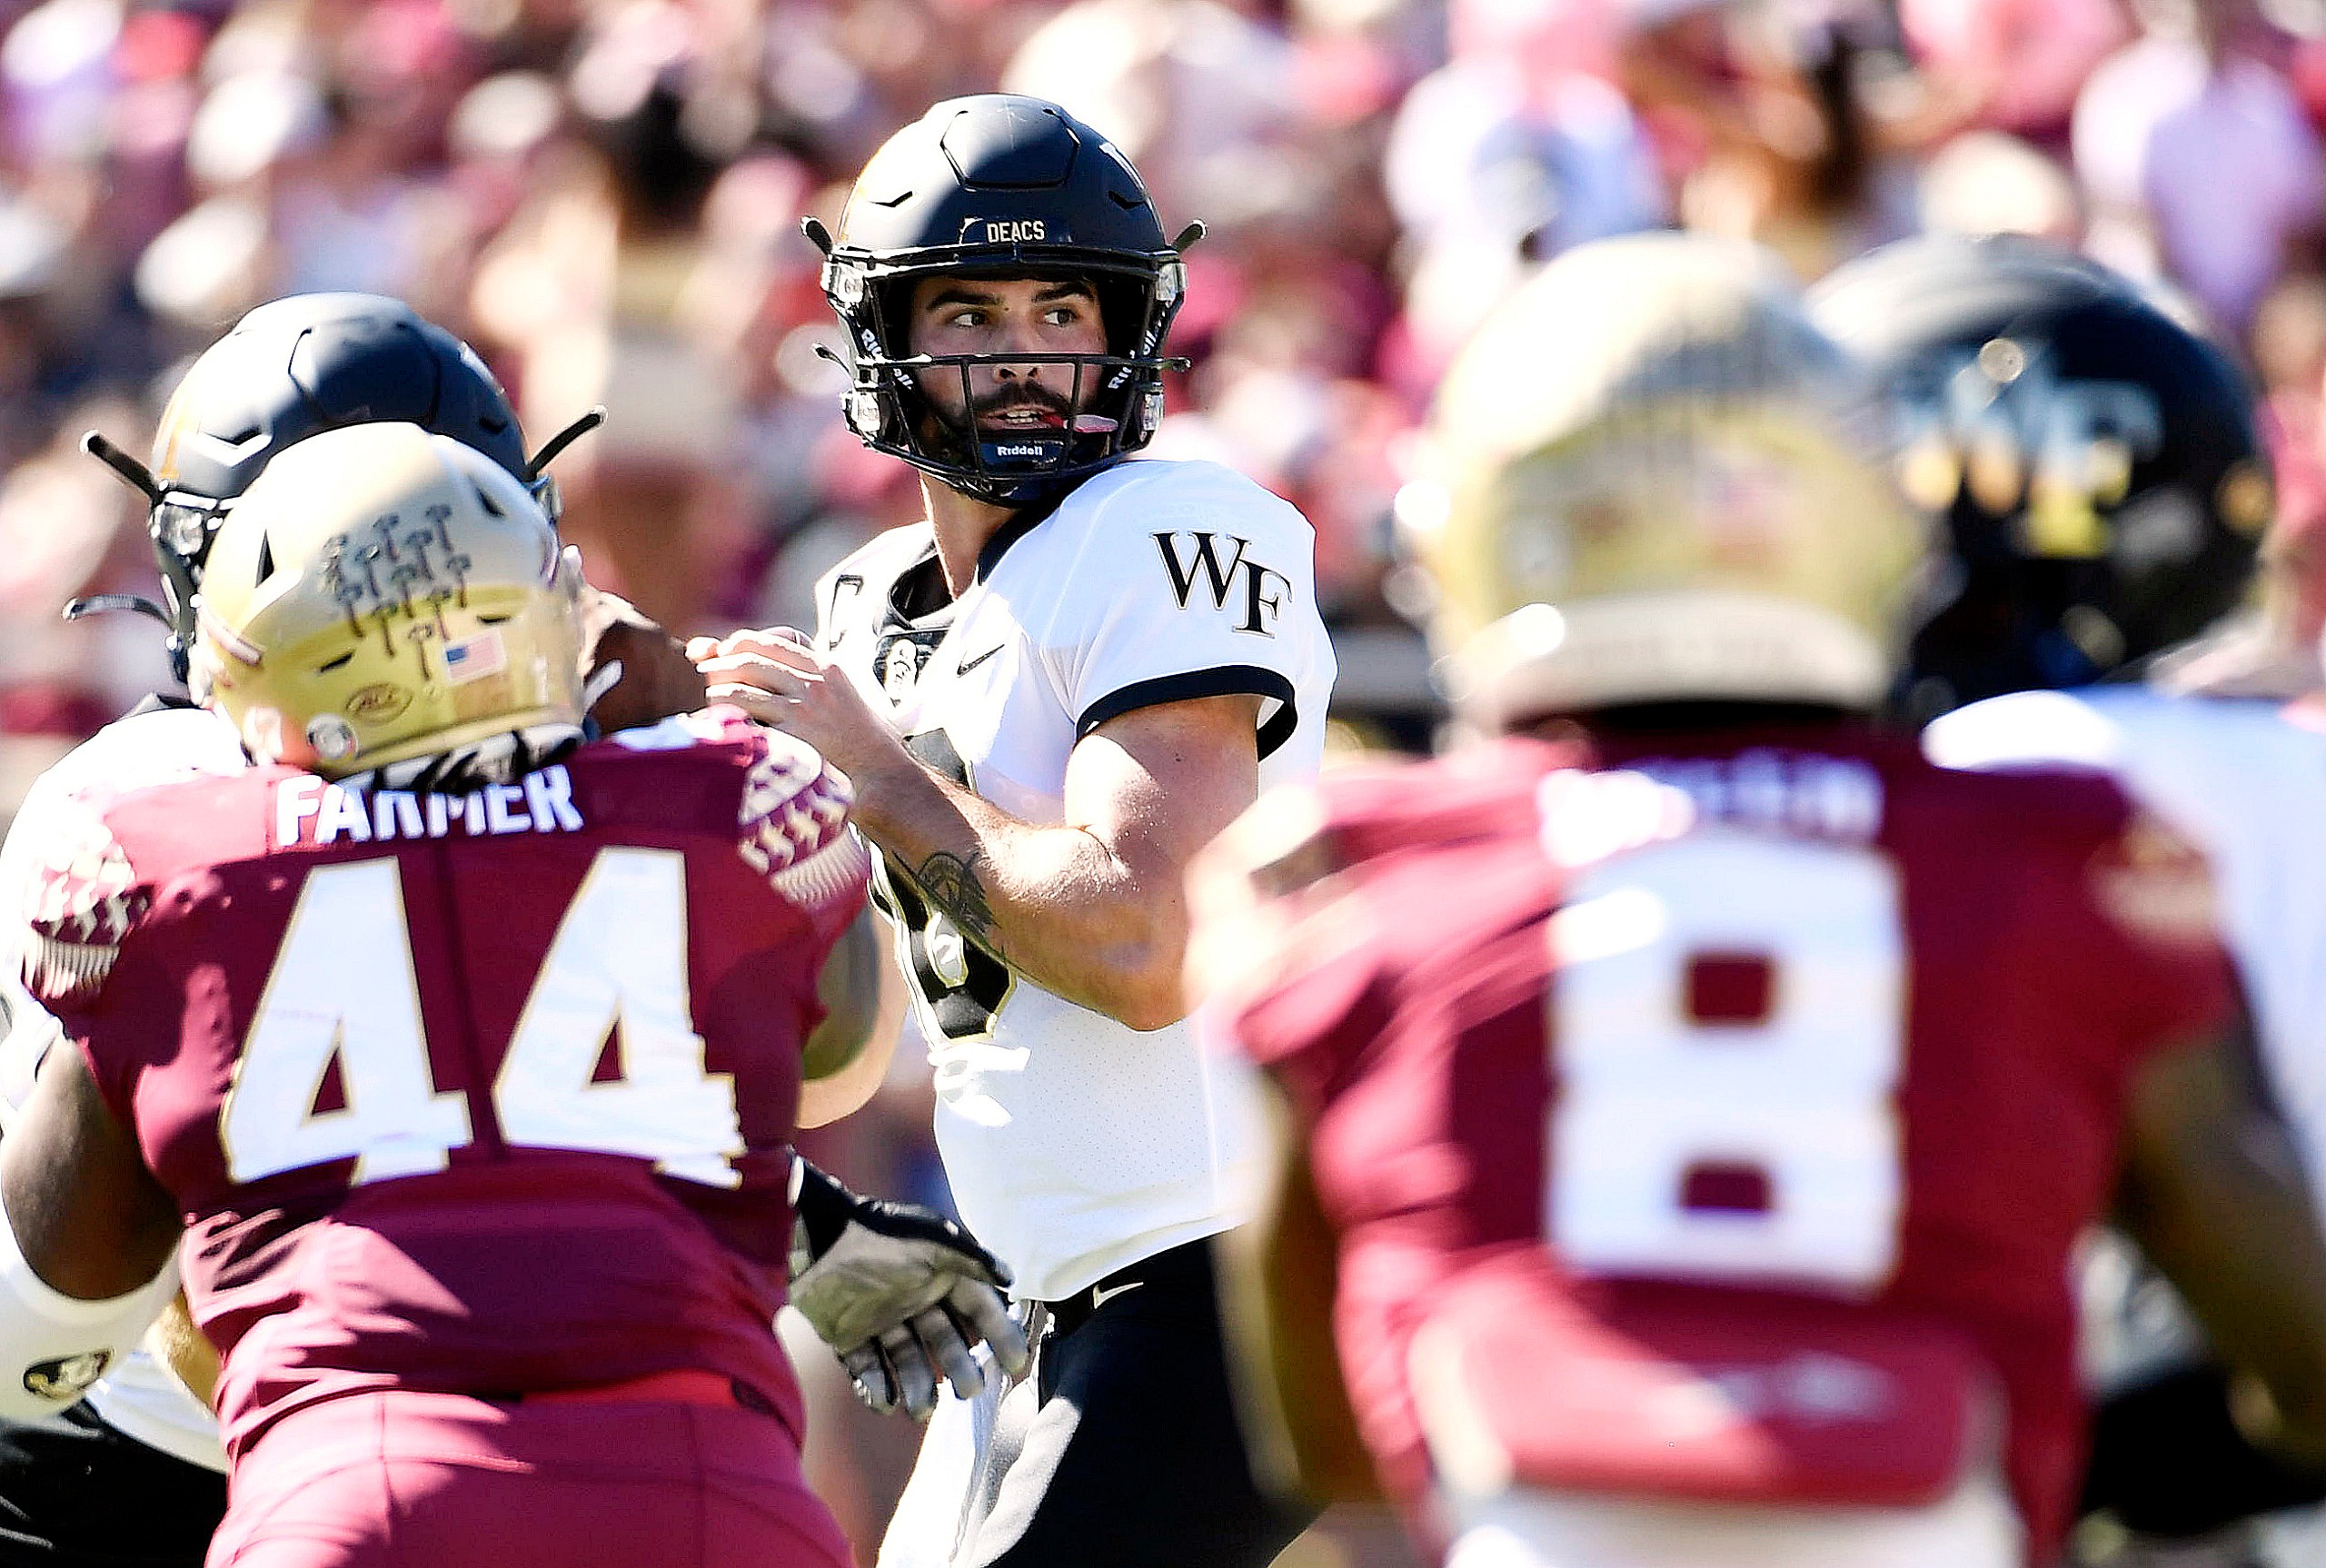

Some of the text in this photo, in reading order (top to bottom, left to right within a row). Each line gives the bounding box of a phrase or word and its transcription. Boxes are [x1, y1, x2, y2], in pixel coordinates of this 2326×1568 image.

[987, 220, 1045, 243] DEACS
[997, 444, 1043, 456] Riddell
[1148, 529, 1294, 639] WF
[276, 763, 585, 847] FARMER
[218, 845, 745, 1190] 44
[1543, 830, 1910, 1299] 8
